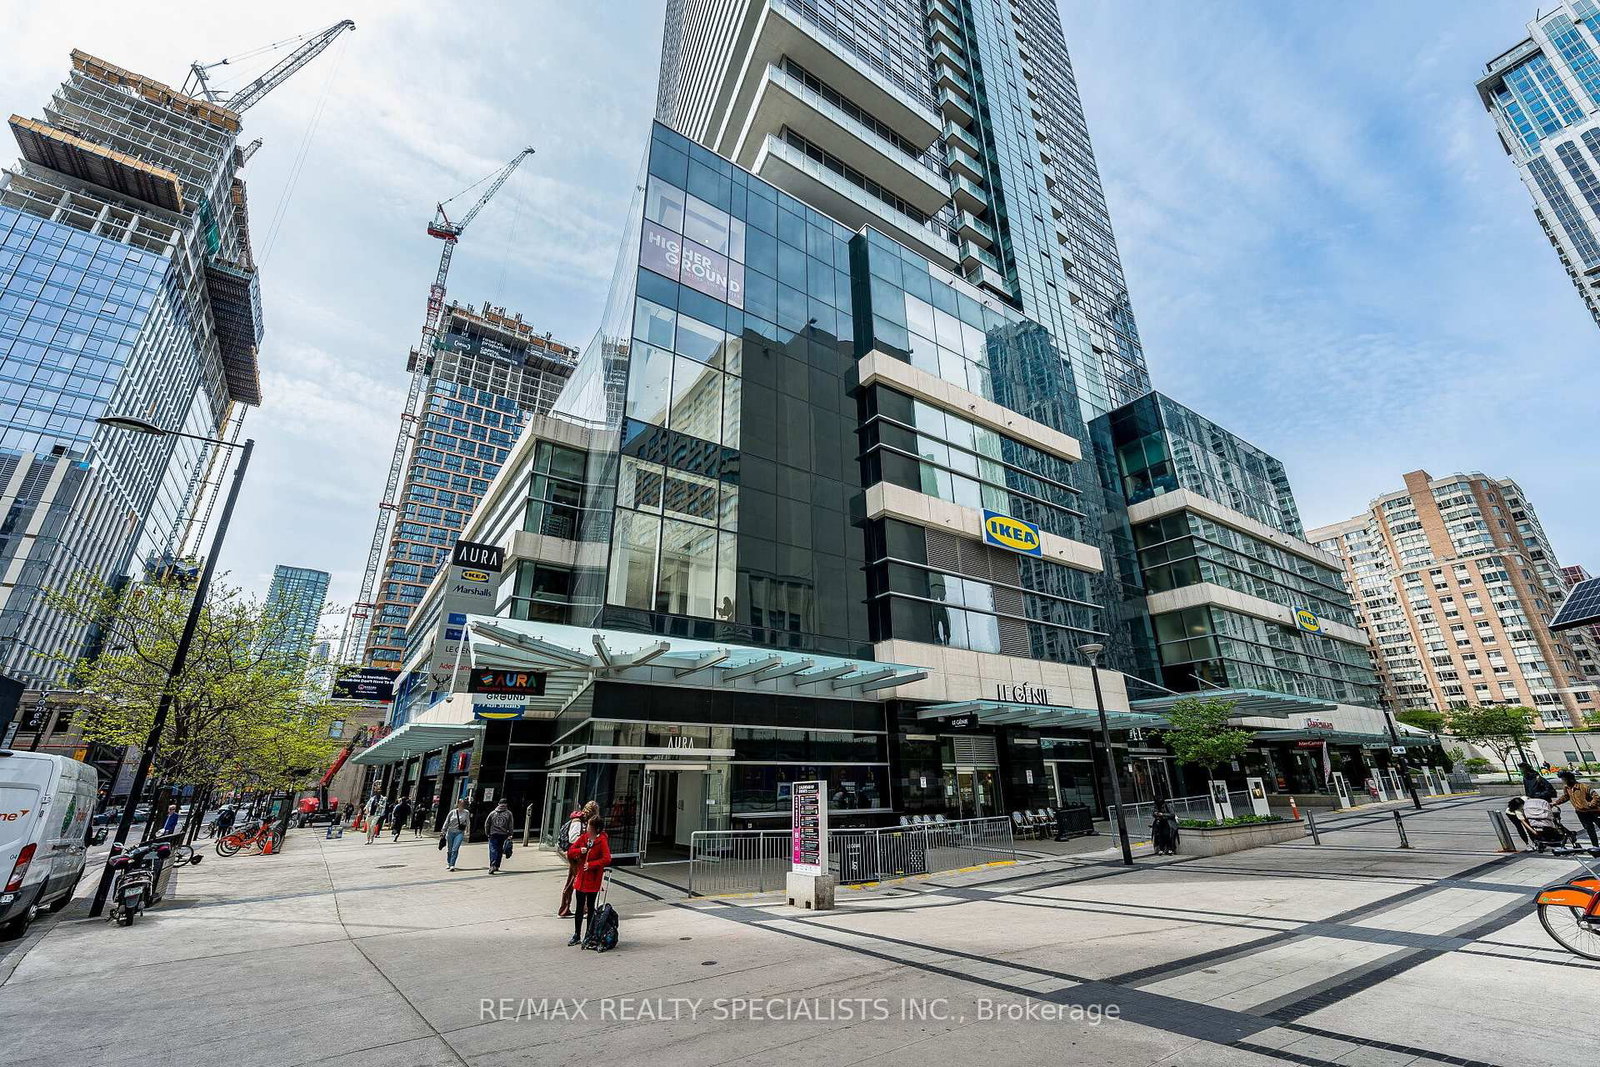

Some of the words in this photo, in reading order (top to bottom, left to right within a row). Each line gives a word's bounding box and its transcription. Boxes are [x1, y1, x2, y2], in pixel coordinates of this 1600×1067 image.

[648, 231, 712, 270] HIGHER
[664, 251, 741, 293] GROUND
[990, 520, 1037, 546] IKEA
[459, 546, 498, 566] AURA
[464, 572, 488, 580] IKEA
[452, 584, 492, 597] Marshalls
[1298, 613, 1319, 628] IKEA
[445, 645, 454, 653] LE
[495, 673, 537, 688] AURA
[486, 693, 526, 701] GROUND
[997, 684, 1012, 702] LE
[667, 736, 694, 749] AURA
